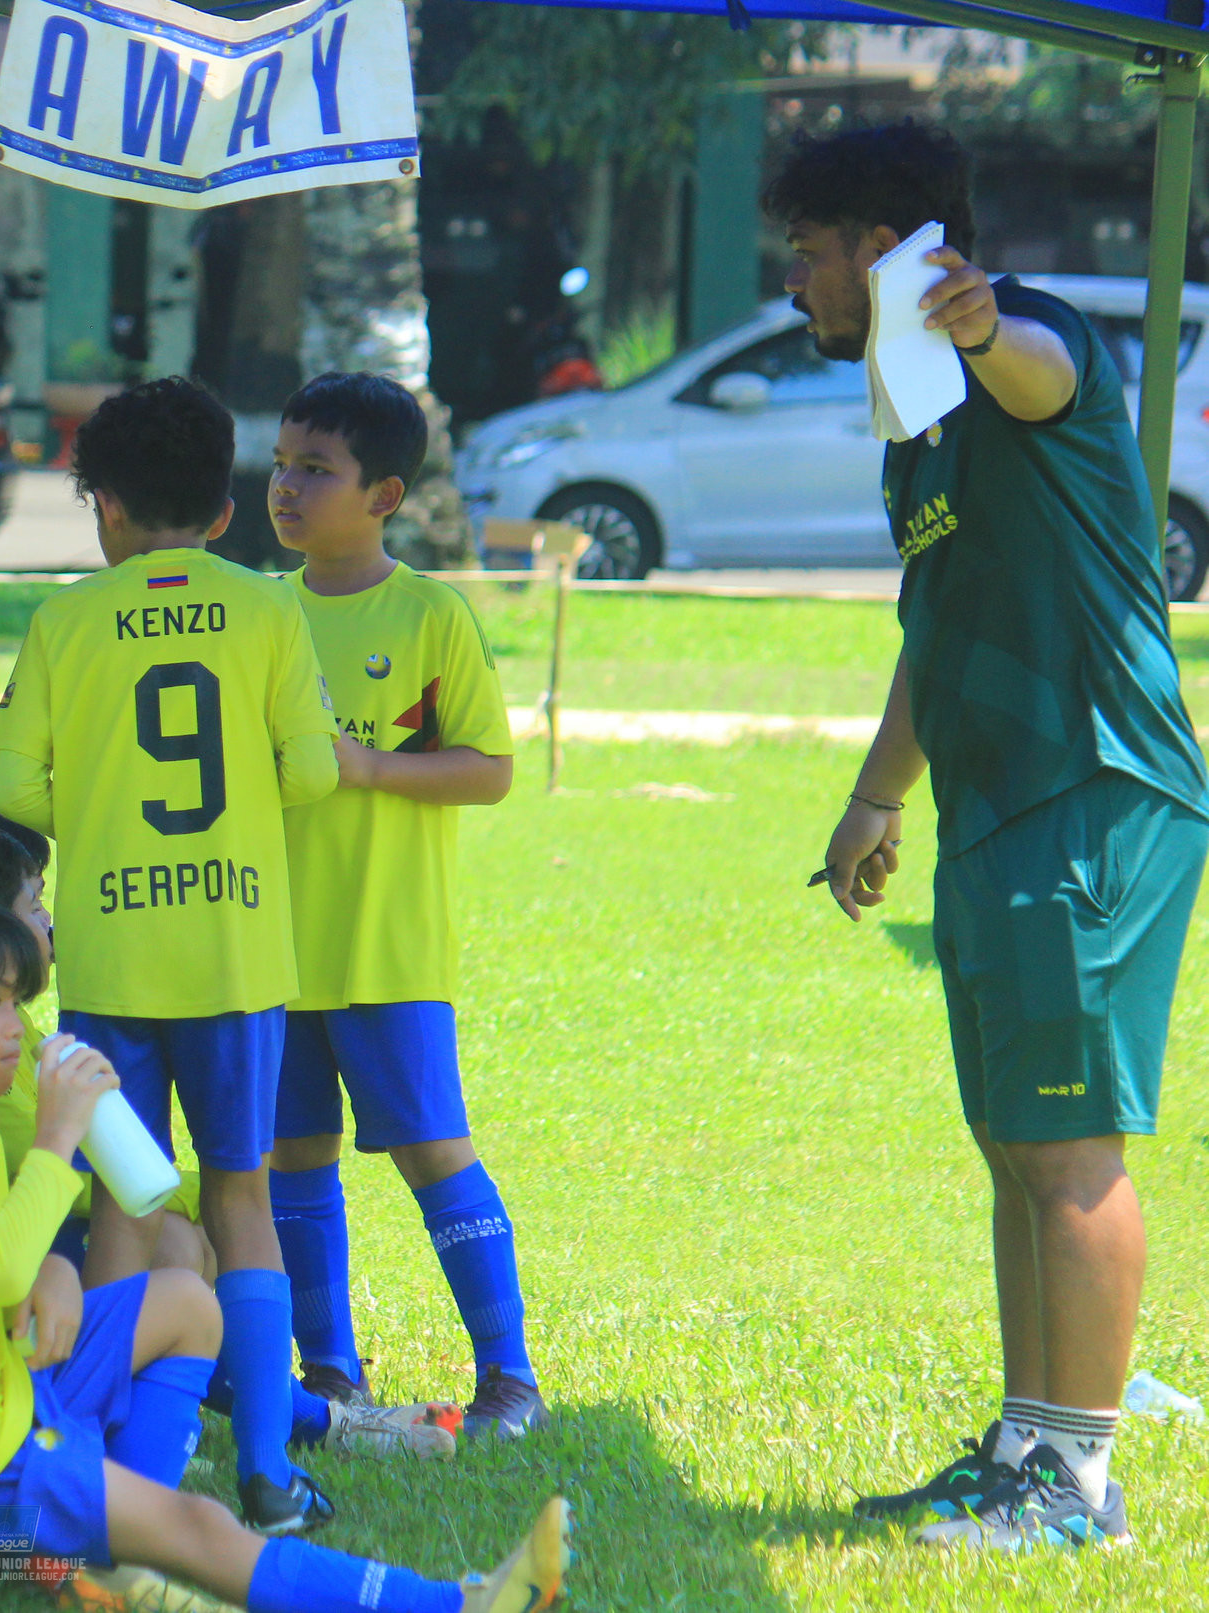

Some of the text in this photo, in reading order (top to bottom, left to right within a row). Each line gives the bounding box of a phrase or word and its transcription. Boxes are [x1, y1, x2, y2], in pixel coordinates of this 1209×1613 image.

[27, 12, 348, 166] AWAY
[116, 602, 226, 640] KENZO
[134, 661, 227, 836] 9
[100, 858, 259, 915] SERPONG
